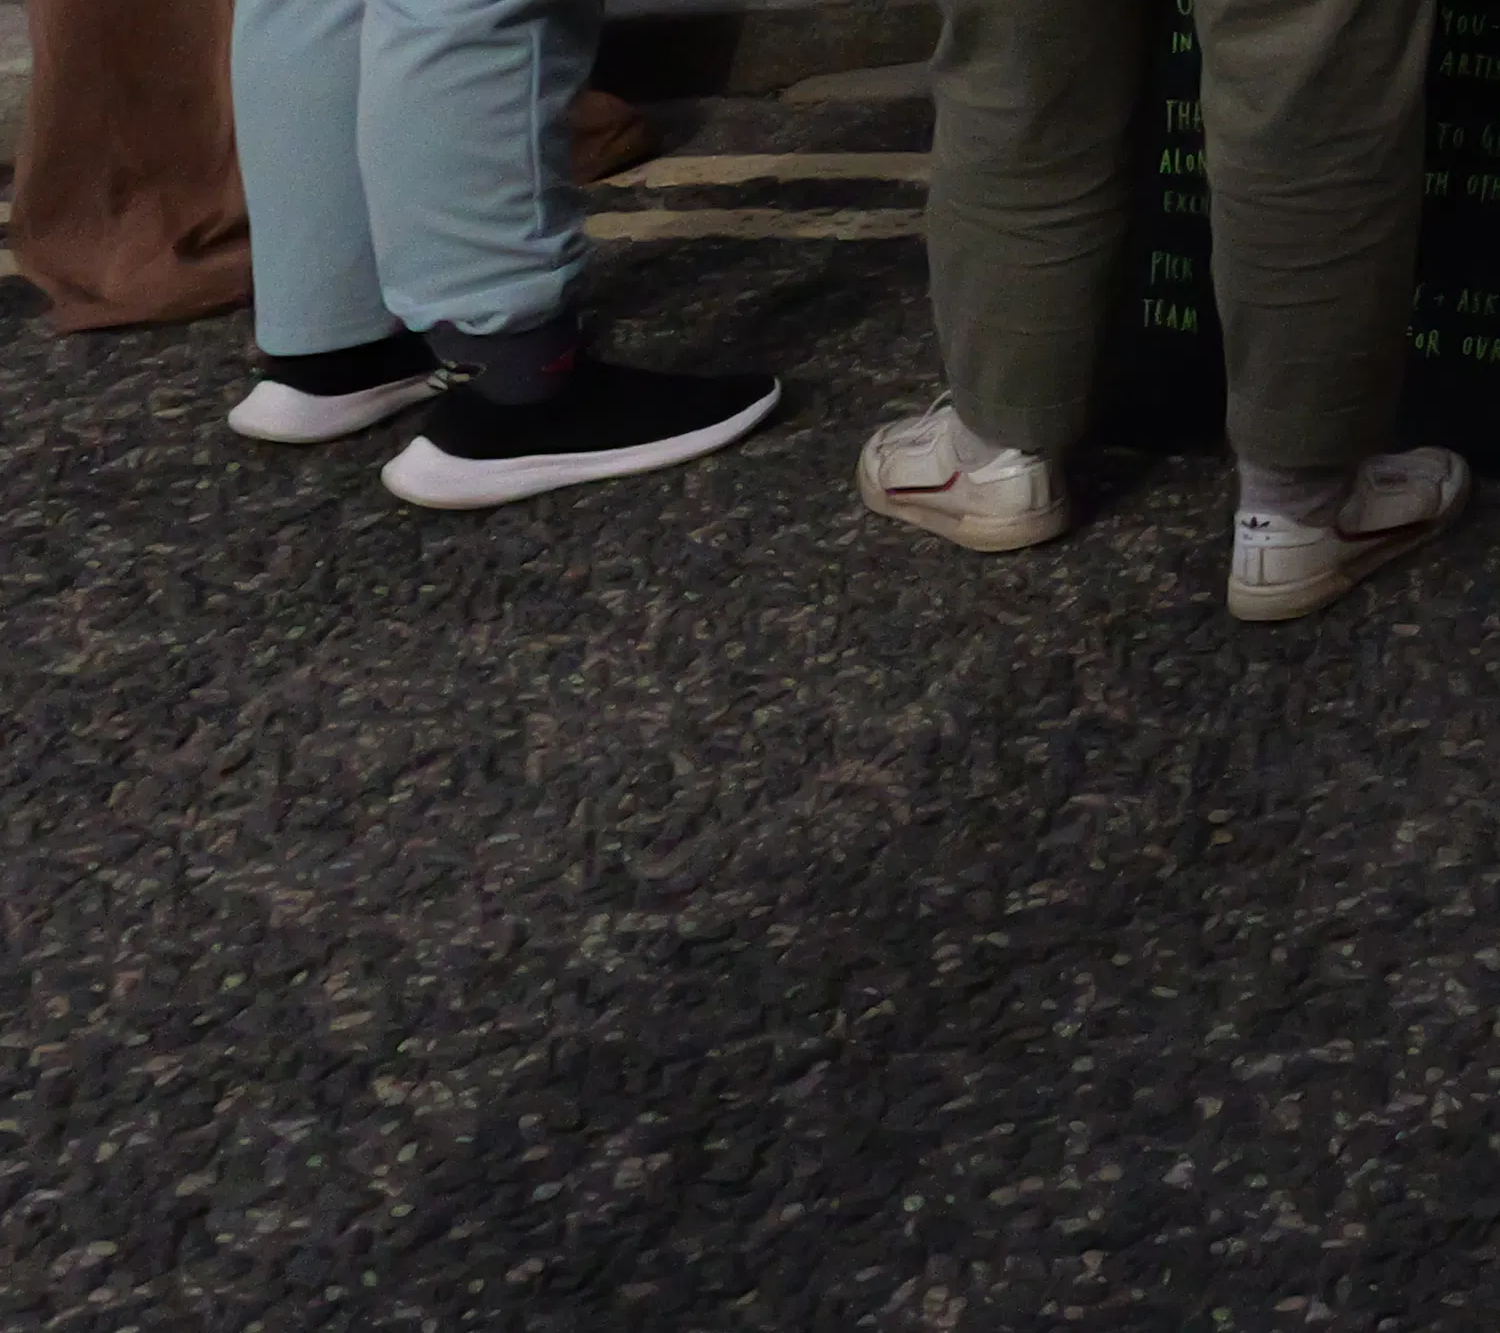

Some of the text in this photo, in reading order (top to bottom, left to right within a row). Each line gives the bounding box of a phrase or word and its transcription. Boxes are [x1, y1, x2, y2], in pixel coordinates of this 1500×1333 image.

[1436, 122, 1464, 150] TO
[1151, 250, 1193, 285] PICK
[1456, 288, 1500, 316] ASK
[1141, 297, 1199, 336] TEAM
